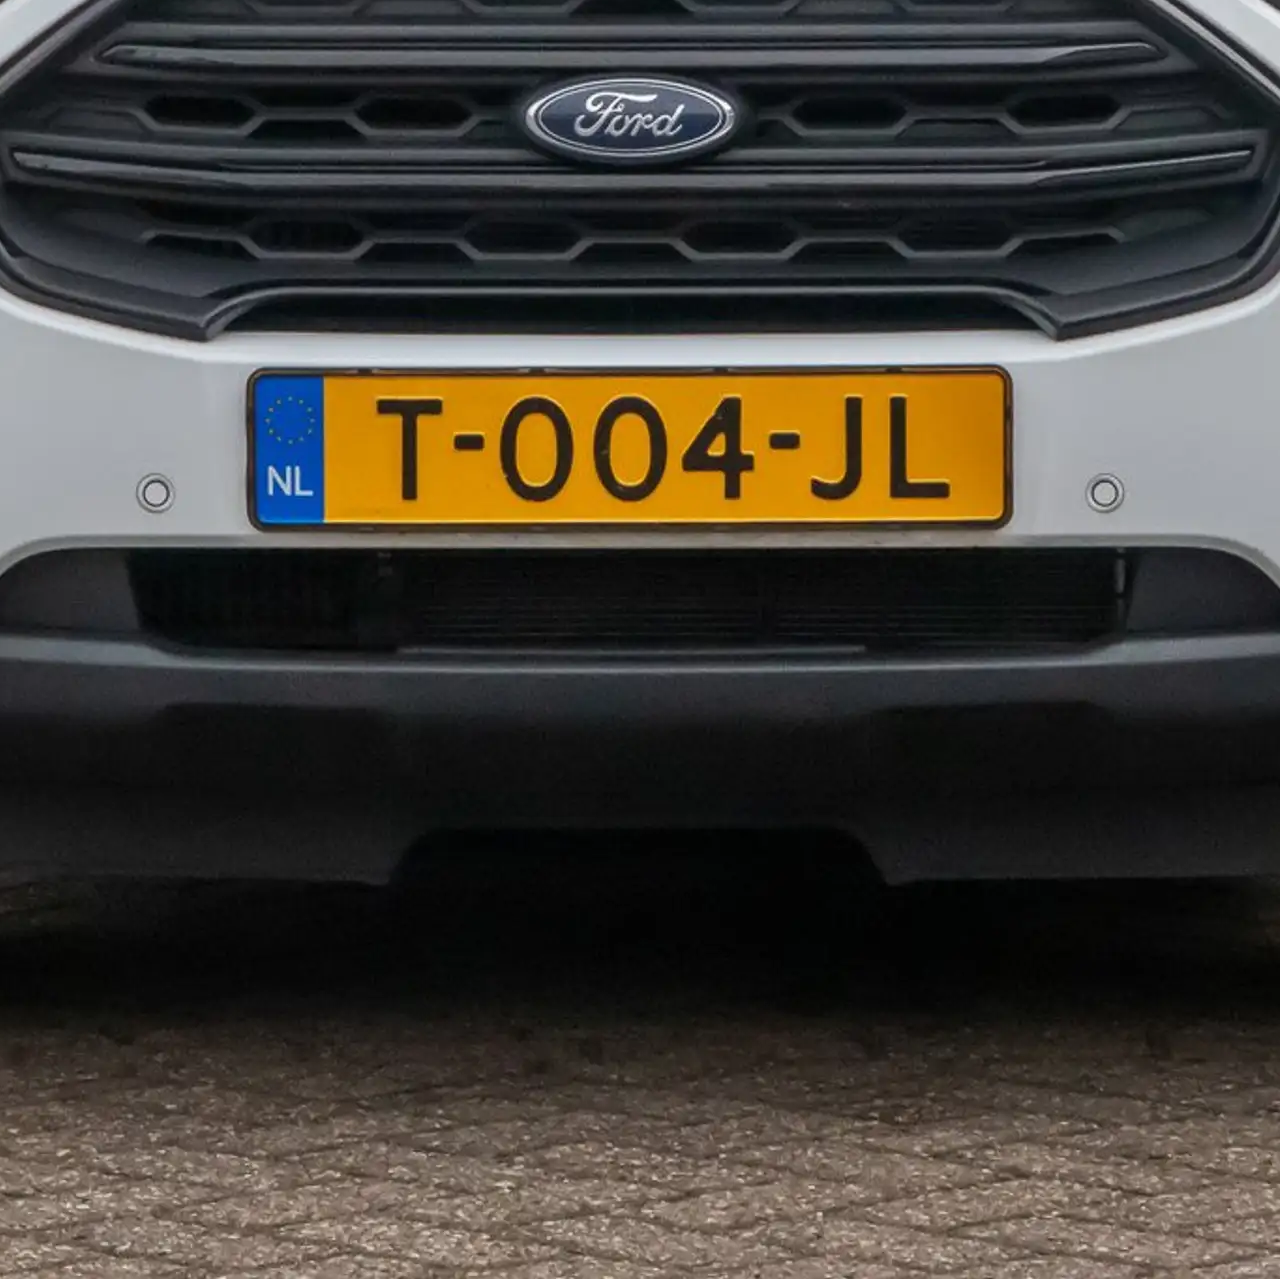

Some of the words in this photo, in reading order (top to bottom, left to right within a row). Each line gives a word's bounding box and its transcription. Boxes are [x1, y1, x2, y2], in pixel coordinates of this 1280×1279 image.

[574, 91, 685, 137] Ford
[375, 395, 951, 503] T-004-JL
[266, 464, 314, 498] NL
